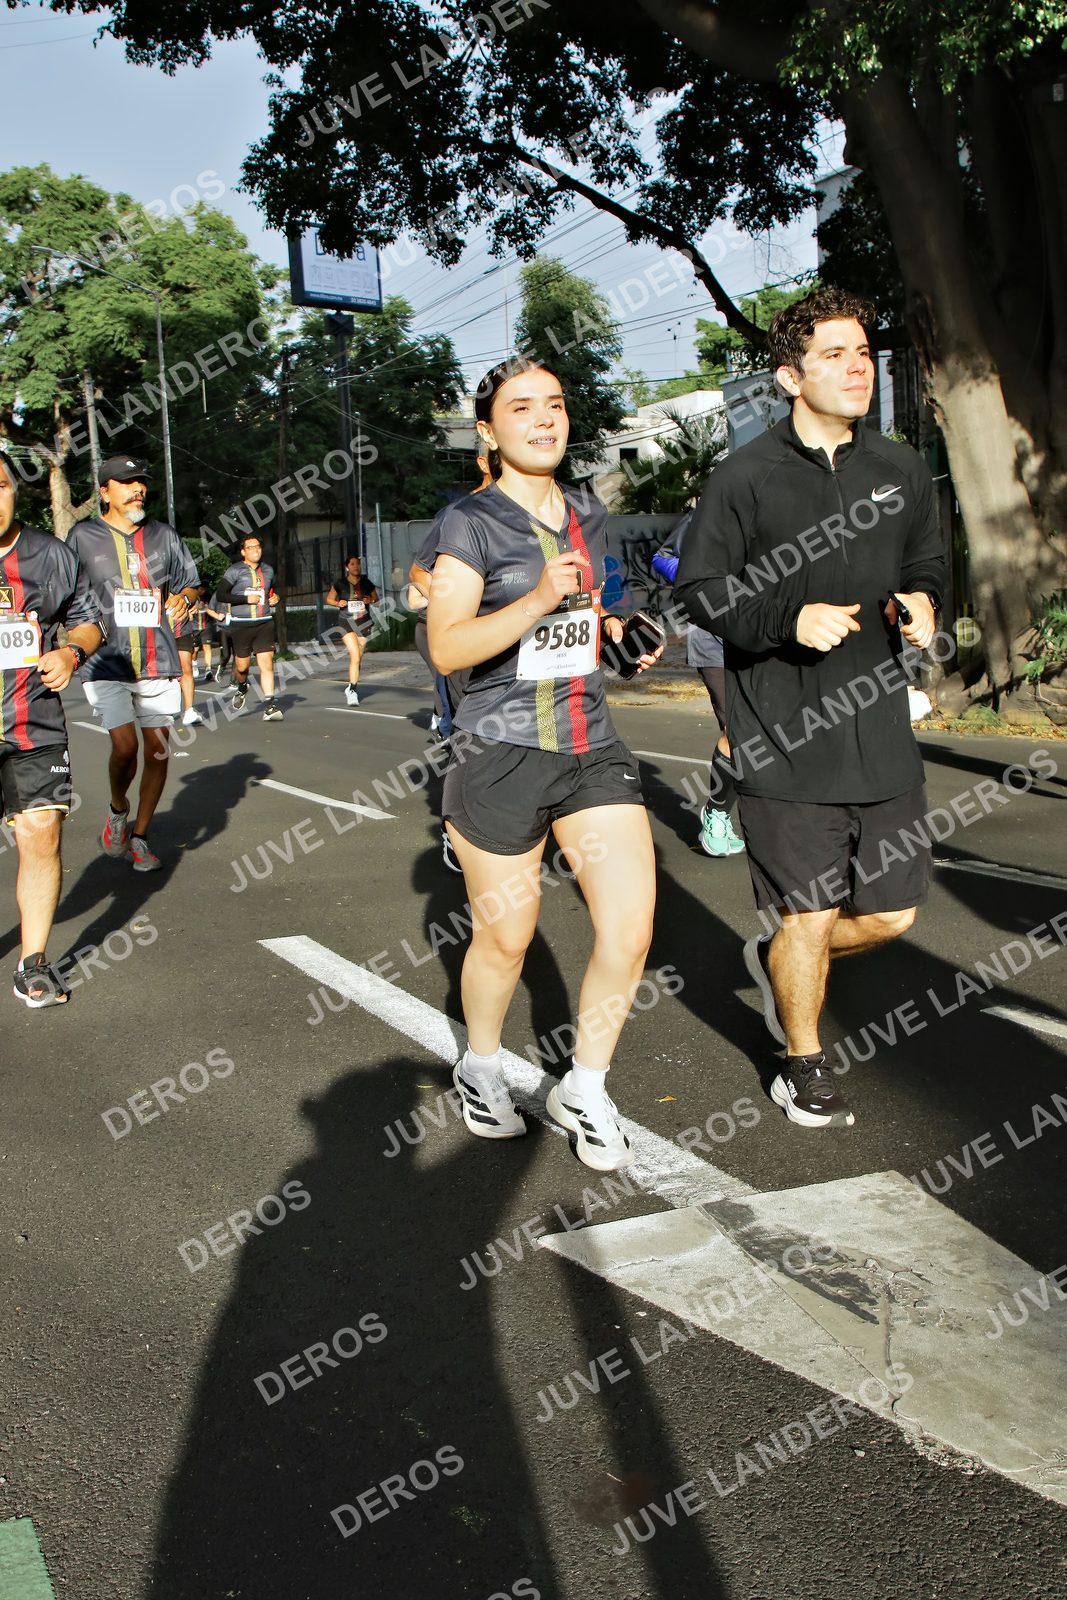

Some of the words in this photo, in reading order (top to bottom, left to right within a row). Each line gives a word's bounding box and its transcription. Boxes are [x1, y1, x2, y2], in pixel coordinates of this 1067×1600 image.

[118, 601, 155, 613] 11807
[1, 629, 34, 649] 089
[534, 619, 590, 651] 9588
